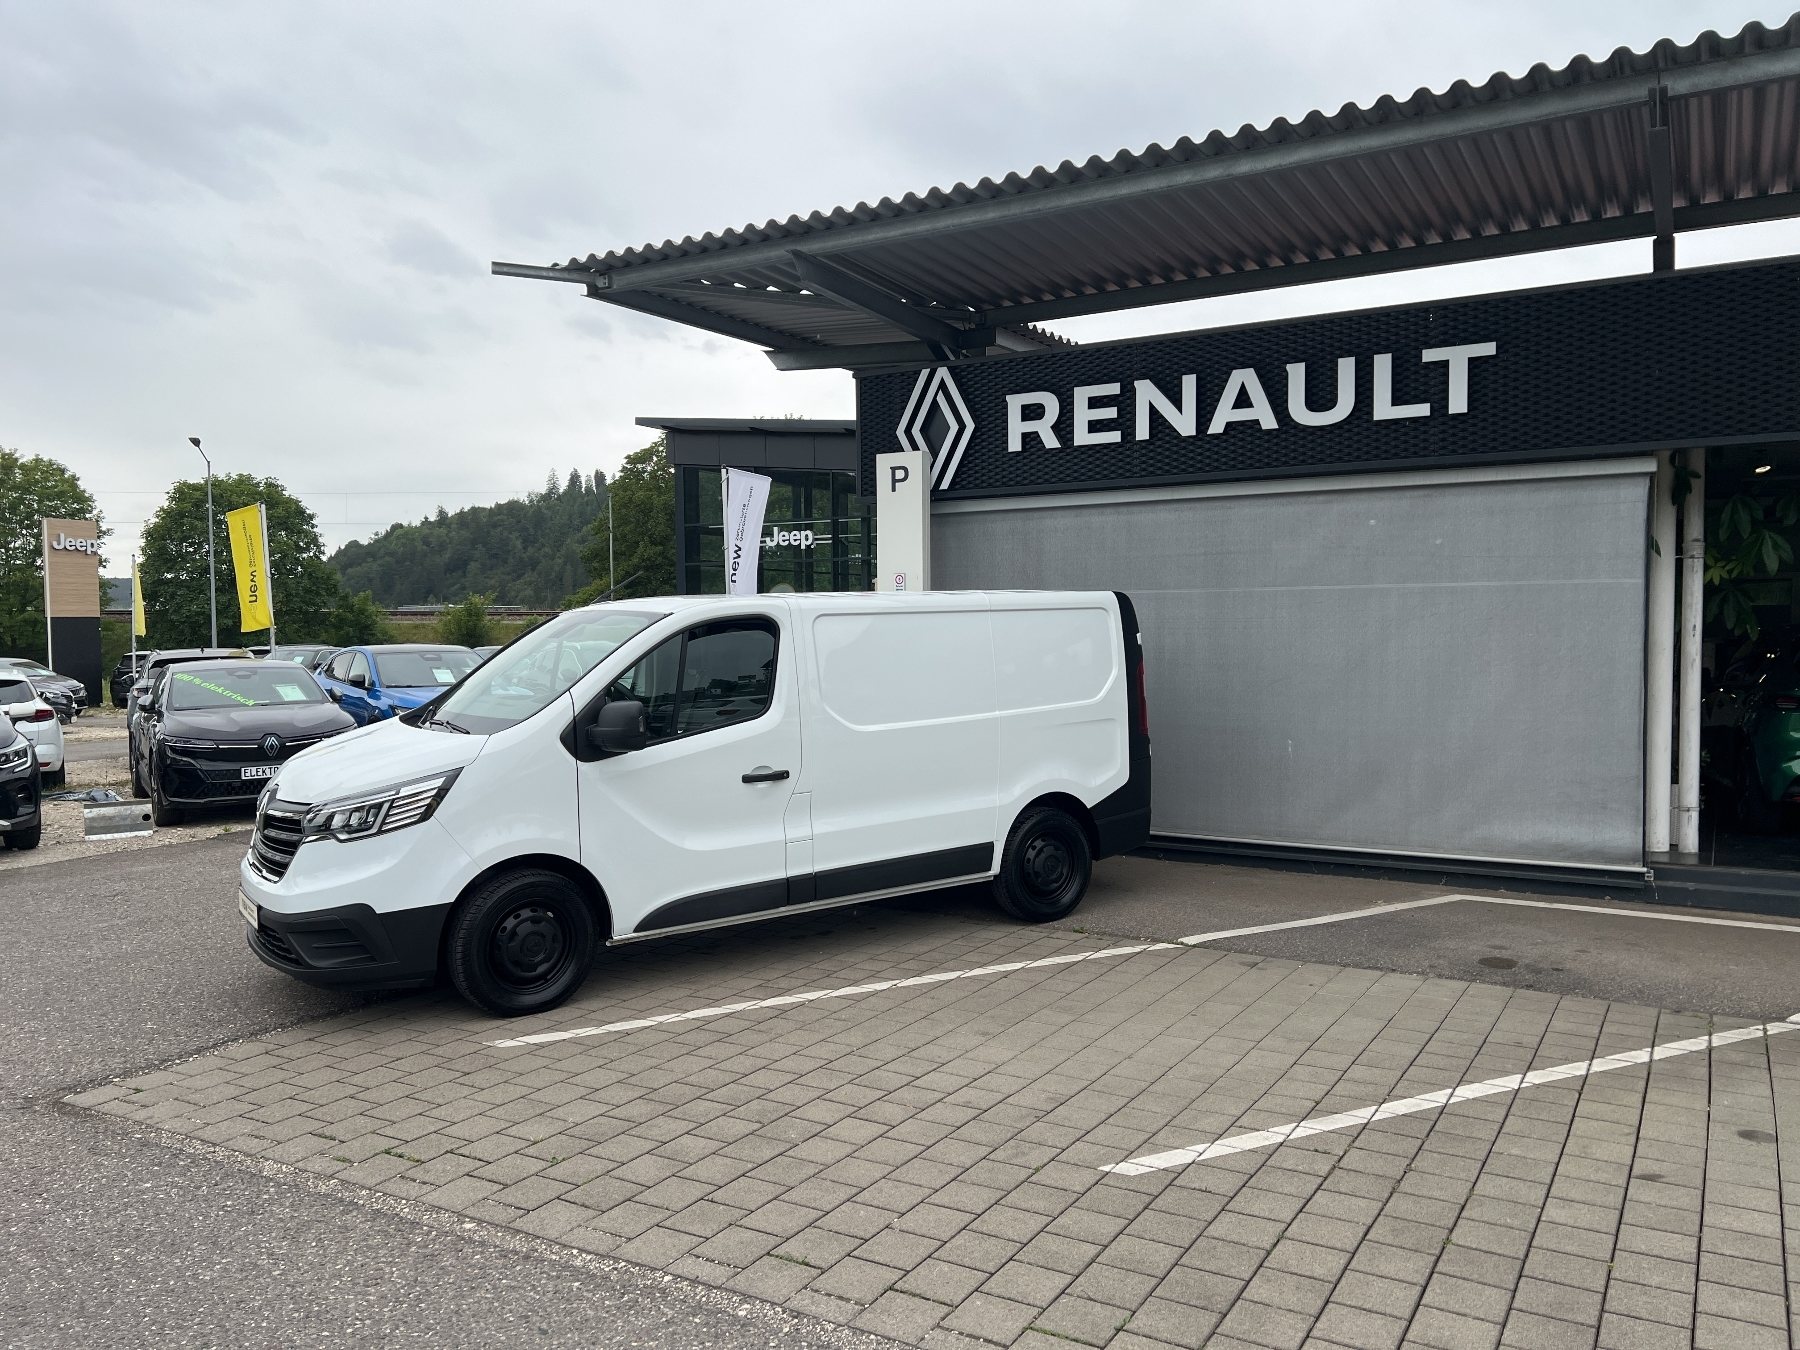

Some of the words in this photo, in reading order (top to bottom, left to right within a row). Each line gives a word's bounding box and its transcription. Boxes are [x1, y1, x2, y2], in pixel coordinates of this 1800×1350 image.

[1006, 341, 1496, 452] RENAULT
[890, 466, 909, 492] P
[53, 533, 97, 554] Jeep
[766, 527, 813, 549] Jeep
[730, 543, 742, 584] new
[201, 682, 255, 706] elektrisch
